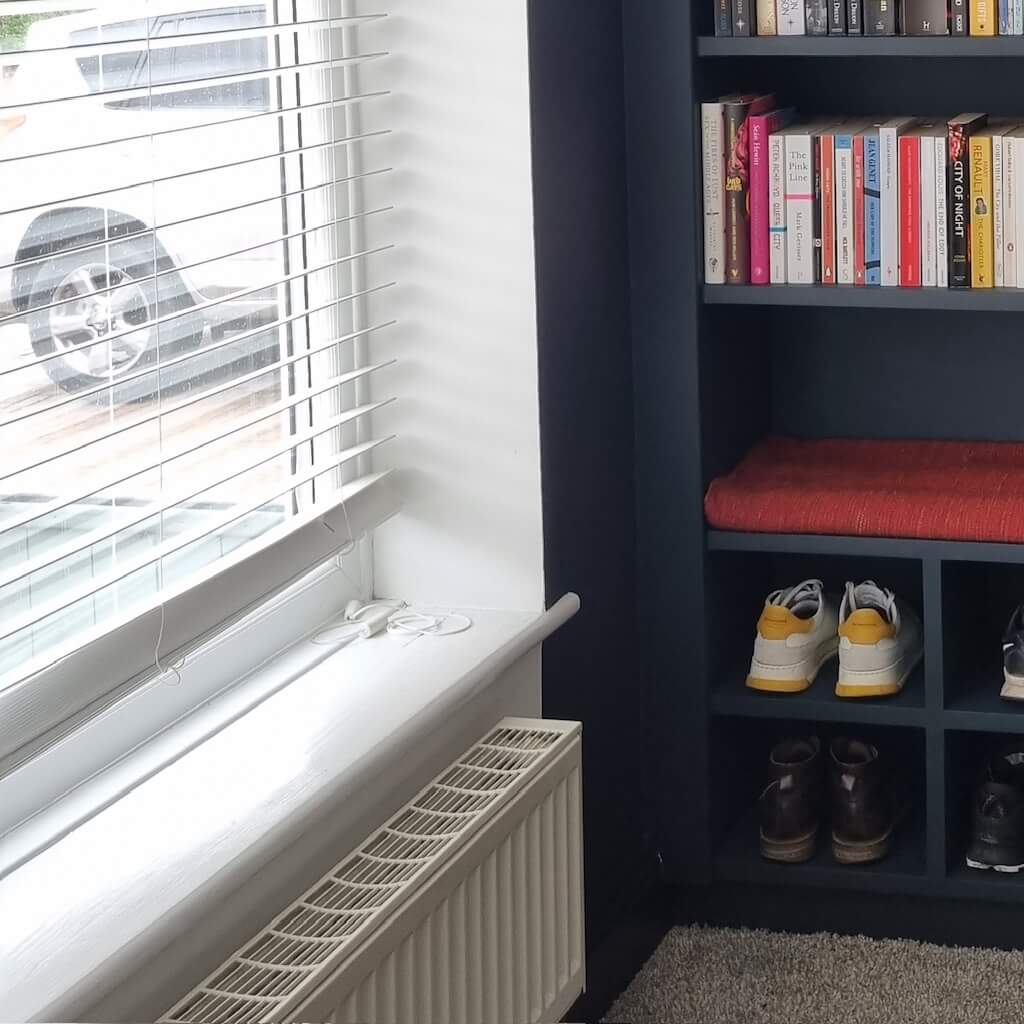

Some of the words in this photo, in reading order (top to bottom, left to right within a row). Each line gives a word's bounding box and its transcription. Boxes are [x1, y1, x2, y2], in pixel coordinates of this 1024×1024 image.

[954, 161, 962, 183] CITY
[974, 145, 982, 193] RENAULT
[954, 185, 962, 200] OF
[955, 203, 964, 238] NIGHT
